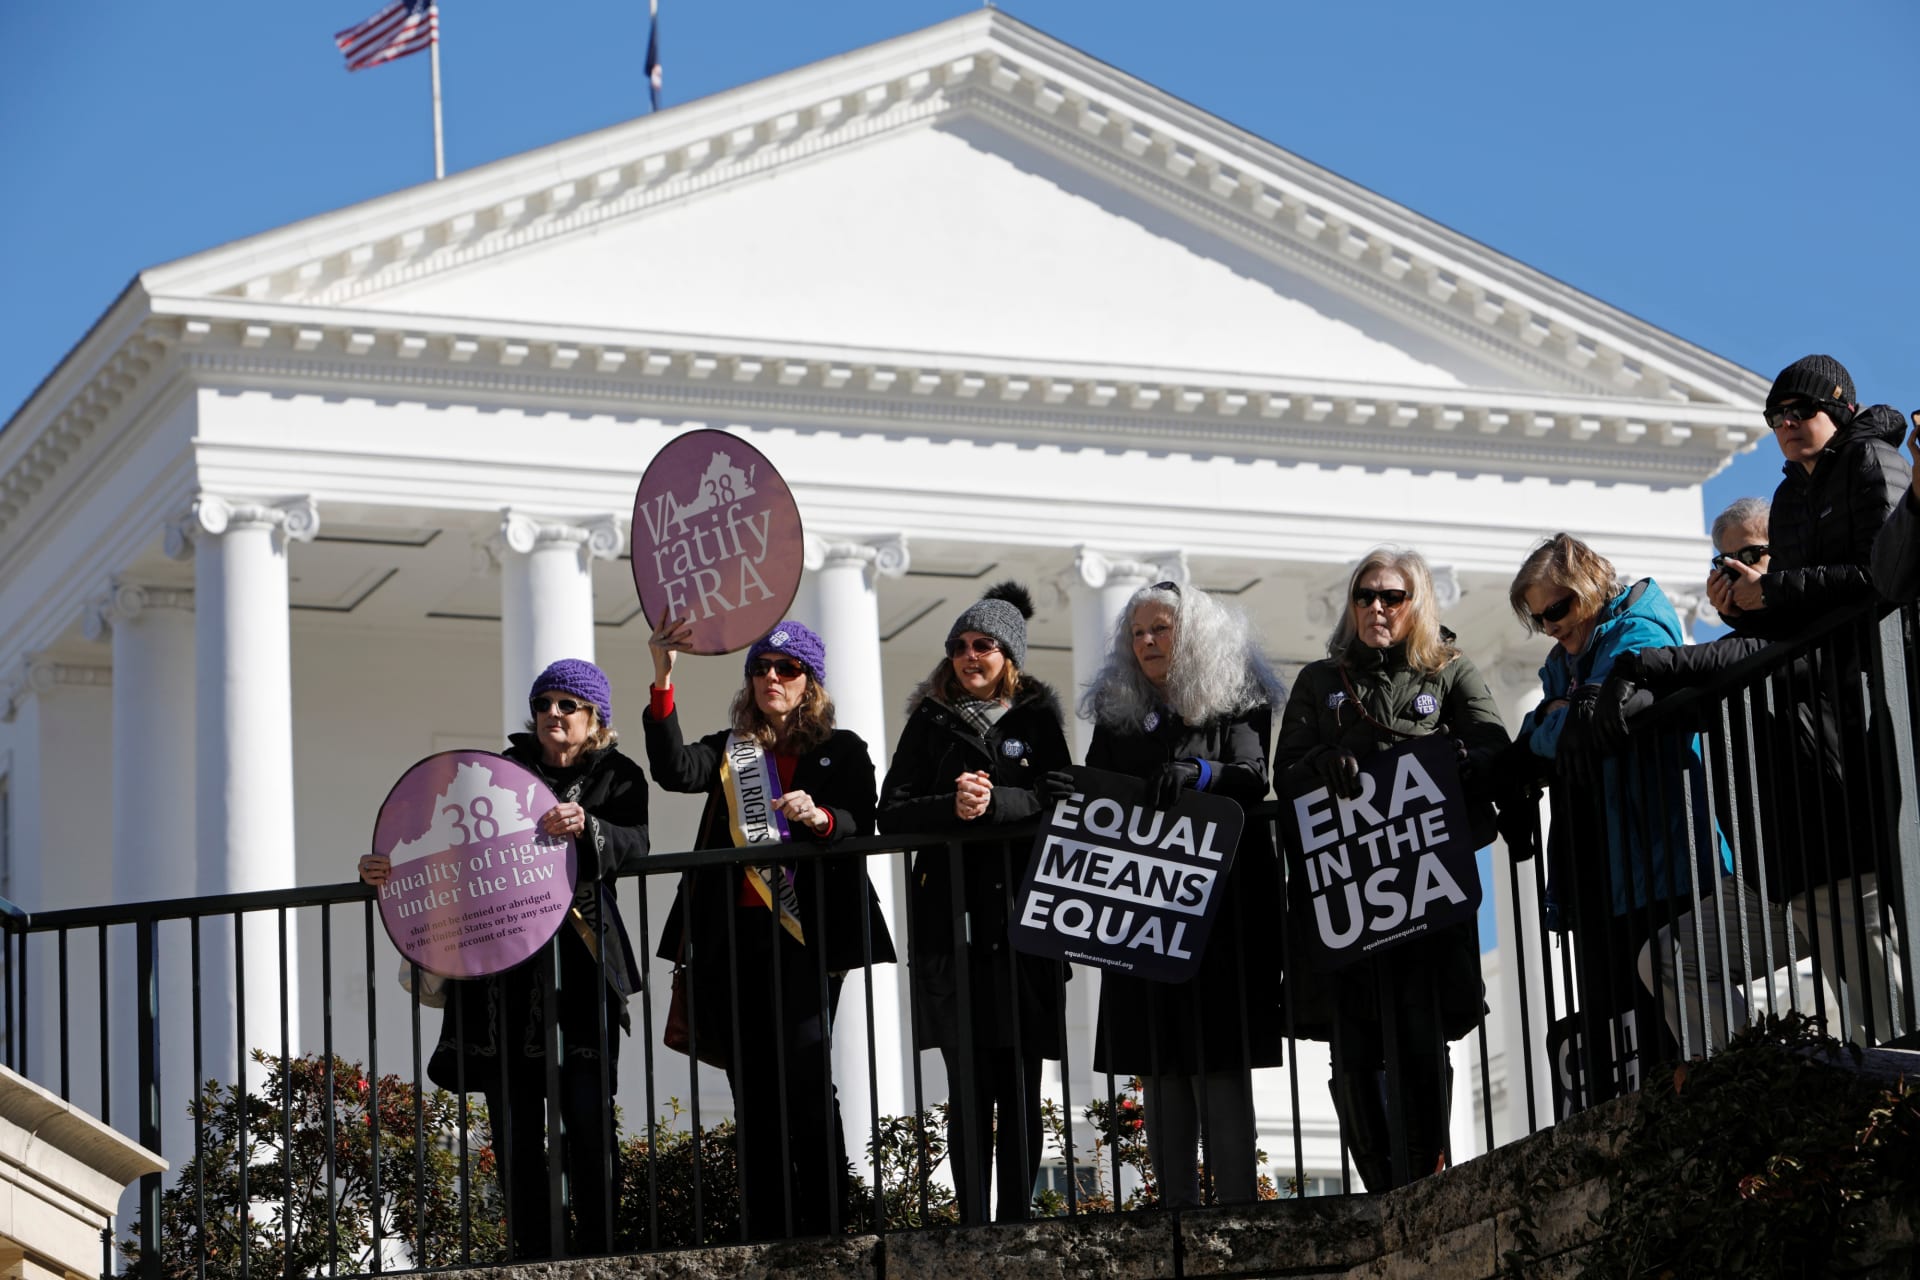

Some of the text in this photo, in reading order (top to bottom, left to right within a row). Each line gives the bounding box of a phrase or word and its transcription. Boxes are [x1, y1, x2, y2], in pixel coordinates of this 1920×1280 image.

[640, 473, 735, 547] VA 38
[652, 503, 772, 584] ratify
[664, 555, 775, 625] ERA
[442, 796, 500, 845] 38
[732, 741, 770, 844] EQUAL RIGHTS
[1293, 752, 1447, 855] ERA
[1051, 792, 1223, 861] EQUAL
[1305, 807, 1450, 893] IN THE
[380, 834, 569, 900] Equality of rights
[397, 863, 555, 918] under the law
[1042, 843, 1208, 907] MEANS
[1313, 851, 1468, 949] USA
[405, 902, 562, 951] by the United States or by any state
[410, 891, 551, 936] shall not be denied or abridged
[444, 924, 526, 952] on account of sex.
[1020, 890, 1192, 960] EQUAL
[1362, 923, 1428, 951] equalmeansequal.org
[1064, 950, 1134, 970] equalmeansequal.org
